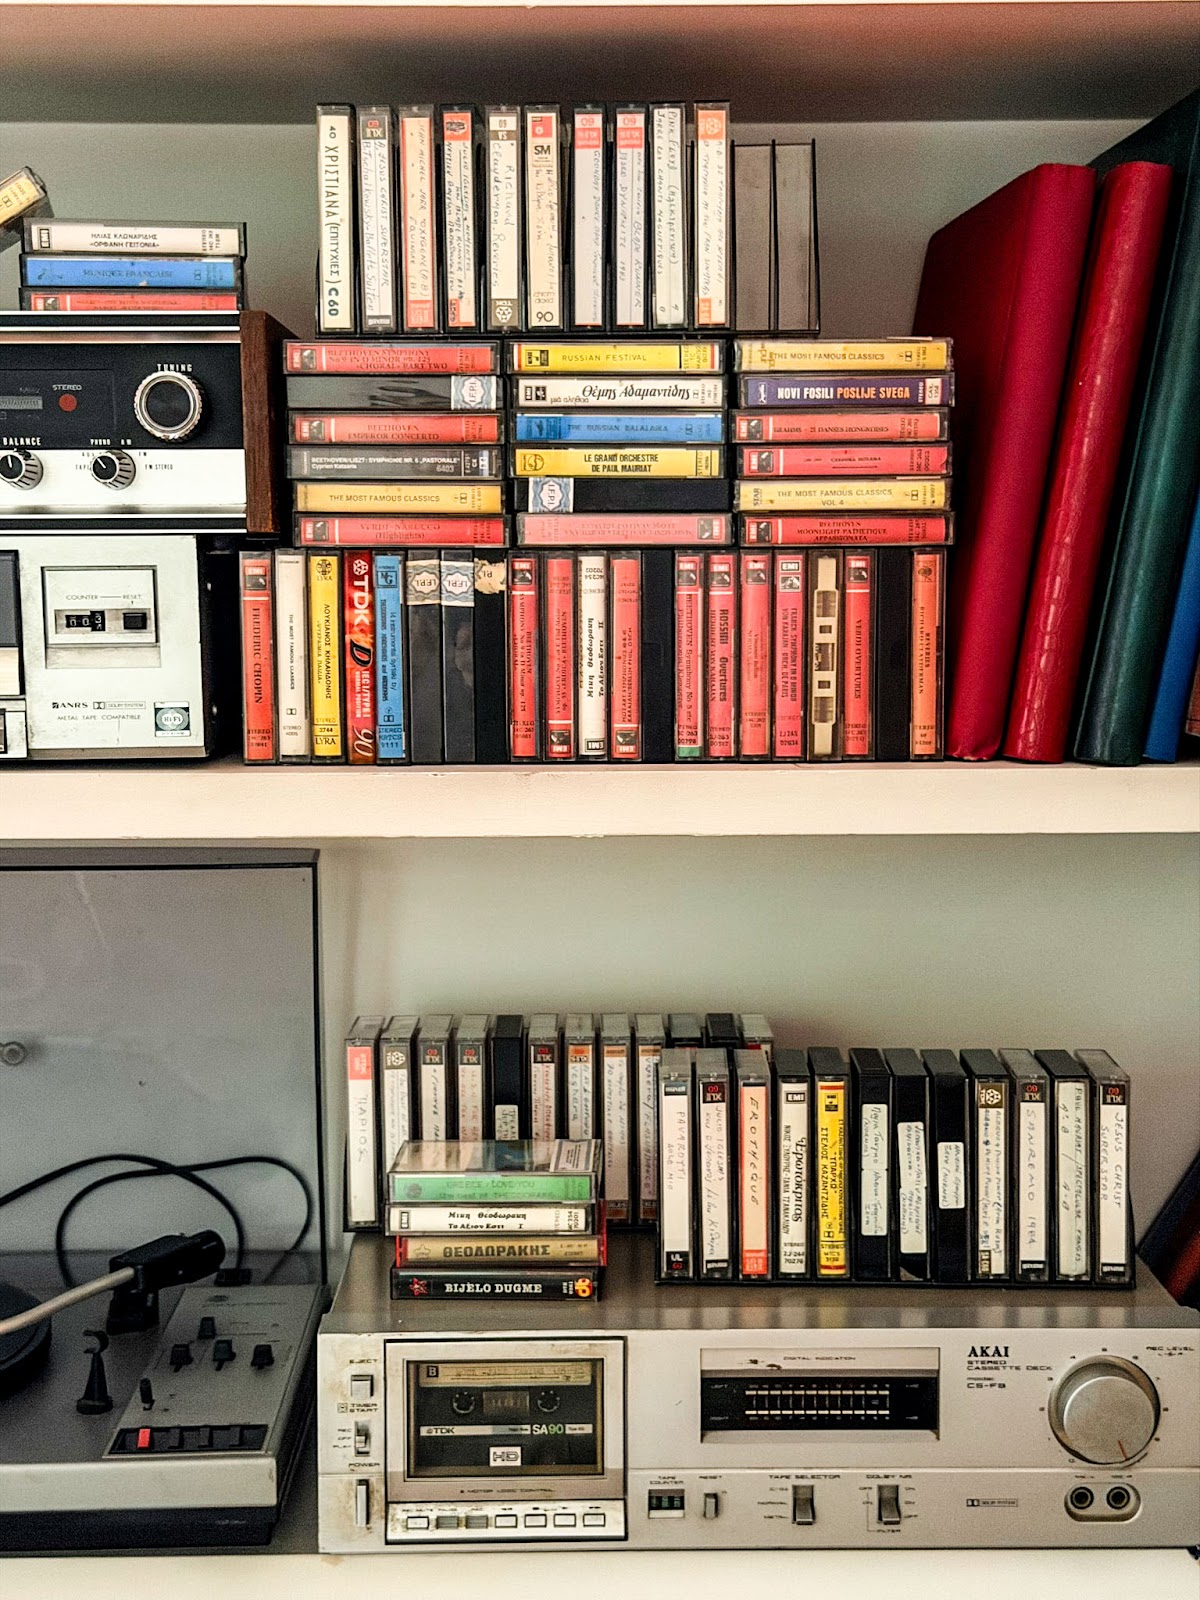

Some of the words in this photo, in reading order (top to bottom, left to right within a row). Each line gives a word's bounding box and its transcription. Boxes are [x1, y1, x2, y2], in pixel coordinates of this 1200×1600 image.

[329, 126, 337, 139] 40
[325, 146, 339, 217] ΧΡΙΣΤΙΑΝΑ
[536, 312, 553, 322] 90
[157, 364, 193, 372] TUNING
[582, 385, 617, 399] Θέμης
[619, 385, 690, 400] Αδαμαντίδης
[778, 387, 801, 399] NOVI
[804, 387, 834, 398] FOSILI
[837, 387, 876, 398] POSLIJE
[879, 387, 910, 398] SVEGA
[3, 437, 42, 446] BALANCE
[619, 454, 659, 462] ORCHESTRE
[782, 562, 798, 571] EMI
[354, 575, 369, 626] TDK
[253, 608, 261, 659] FREDERIC
[719, 609, 729, 645] ROSSINI
[781, 622, 789, 648] KARAJAN
[350, 640, 372, 667] D
[685, 649, 693, 689] Symphony
[719, 657, 728, 702] Overtures
[854, 648, 862, 700] OVERTURES
[253, 664, 262, 704] CHOPIN
[352, 726, 374, 756] 90
[787, 1093, 804, 1101] EMI
[1115, 1112, 1123, 1152] JESUS
[1027, 1109, 1036, 1201] SANREMO
[821, 1164, 829, 1219] ΚΑΖΑΝΤΖΙΔΗΣ
[1115, 1164, 1123, 1208] CHRIST
[443, 1245, 550, 1258] ΘΕΟΔΩΡΑΚΗΣ
[444, 1283, 491, 1293] BIJELO
[495, 1284, 542, 1293] DUGME
[967, 1346, 1009, 1357] AKAI
[428, 1367, 436, 1376] B
[533, 1424, 564, 1434] SA90
